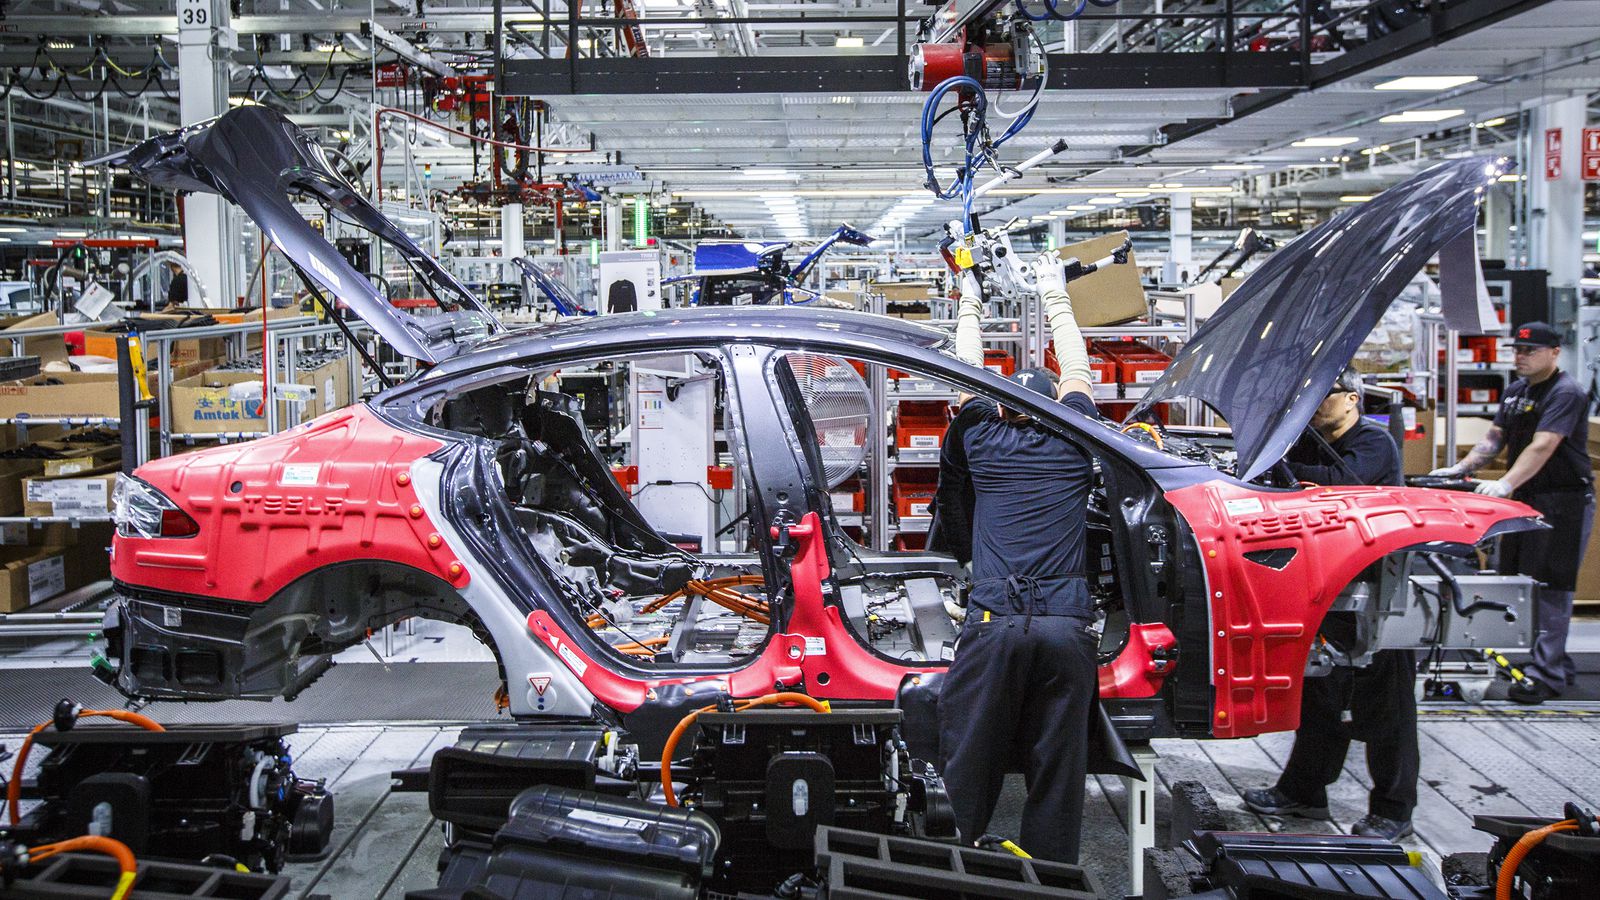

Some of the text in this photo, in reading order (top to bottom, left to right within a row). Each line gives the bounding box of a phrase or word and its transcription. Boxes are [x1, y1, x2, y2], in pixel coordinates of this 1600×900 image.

[184, 8, 207, 25] 39
[193, 409, 240, 421] Amtek
[243, 494, 343, 517] TESLA
[1238, 509, 1345, 536] TESLA
